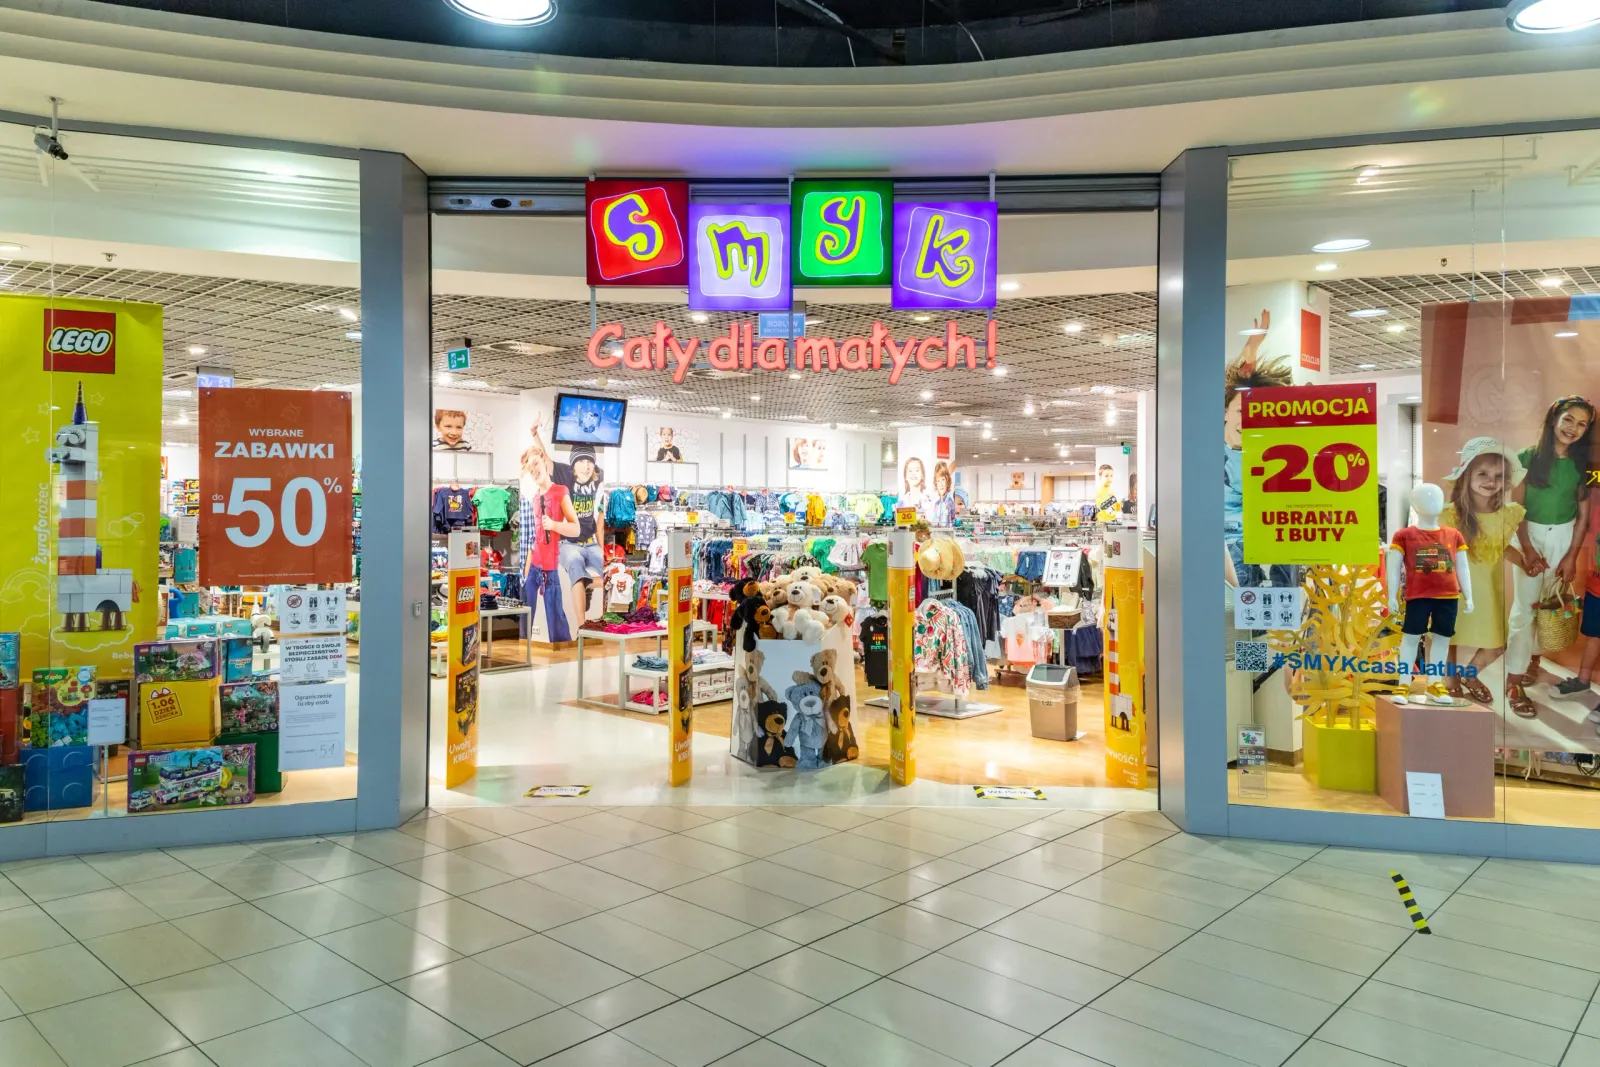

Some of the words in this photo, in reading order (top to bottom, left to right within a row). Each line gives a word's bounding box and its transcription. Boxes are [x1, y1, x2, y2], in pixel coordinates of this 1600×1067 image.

[48, 327, 112, 355] LEGO
[708, 321, 788, 371] dla
[1248, 397, 1369, 419] PROMOCJA
[248, 428, 304, 438] WYBRANE
[214, 441, 335, 459] ZABAWKI
[211, 493, 224, 501] do
[31, 481, 50, 565] Żyraforożec
[1262, 510, 1359, 525] UBRANIA
[1275, 528, 1285, 542] I
[1289, 527, 1345, 542] BUTY
[457, 586, 475, 603] LEGO
[151, 697, 175, 710] 1.06
[294, 693, 333, 701] Ograniczenie
